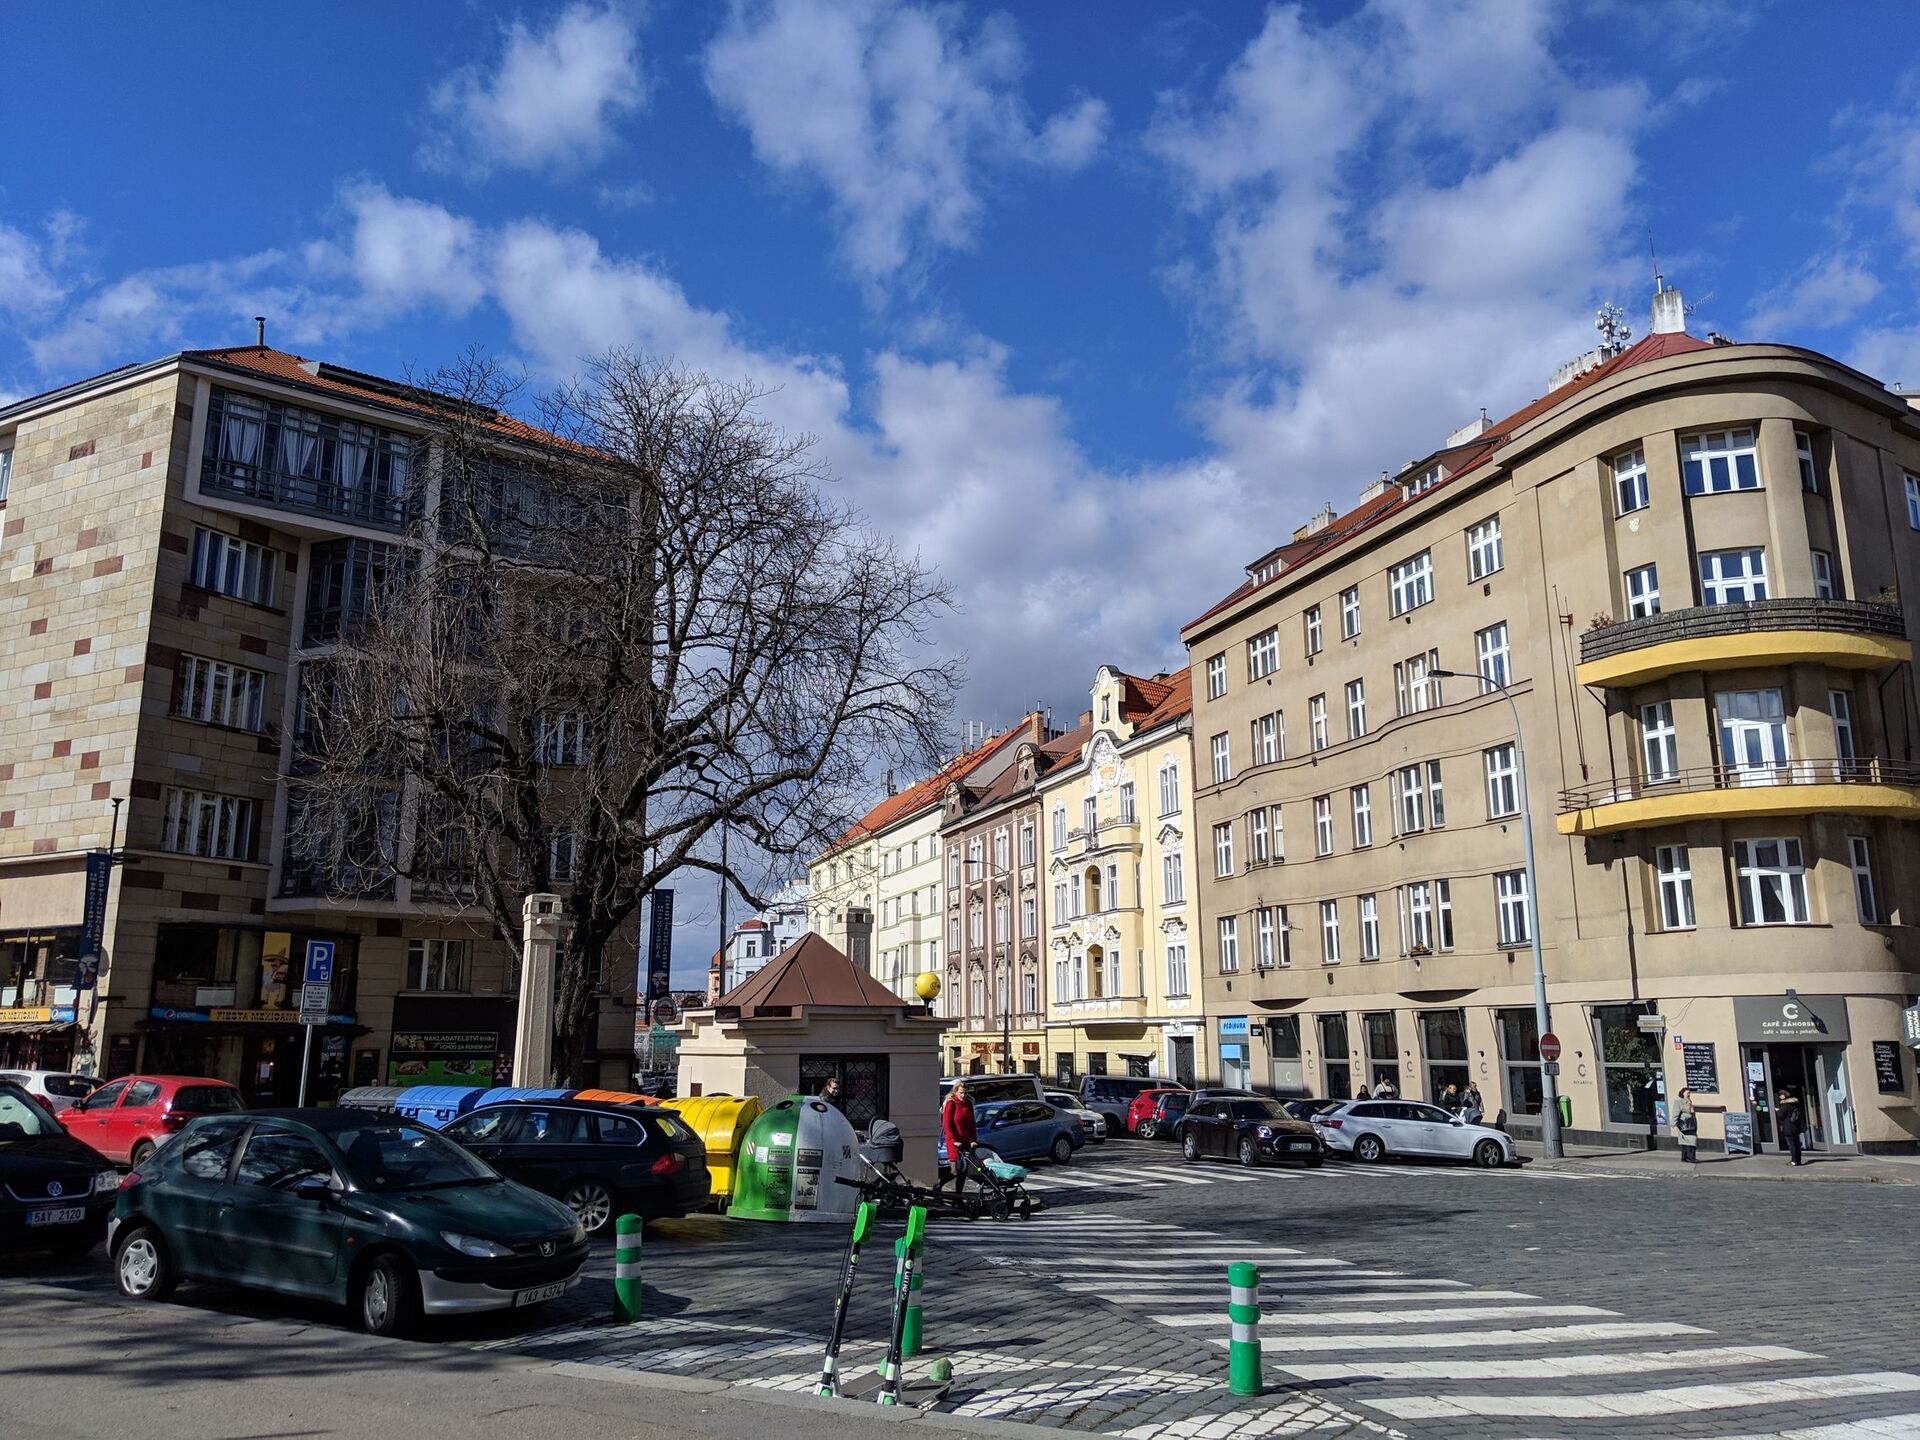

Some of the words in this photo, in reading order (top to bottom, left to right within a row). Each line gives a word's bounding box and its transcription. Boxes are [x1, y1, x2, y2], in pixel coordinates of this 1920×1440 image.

[312, 946, 328, 970] P
[216, 1011, 248, 1021] FIESTA
[251, 1011, 299, 1022] MEXICANA
[58, 1208, 81, 1221] 2120
